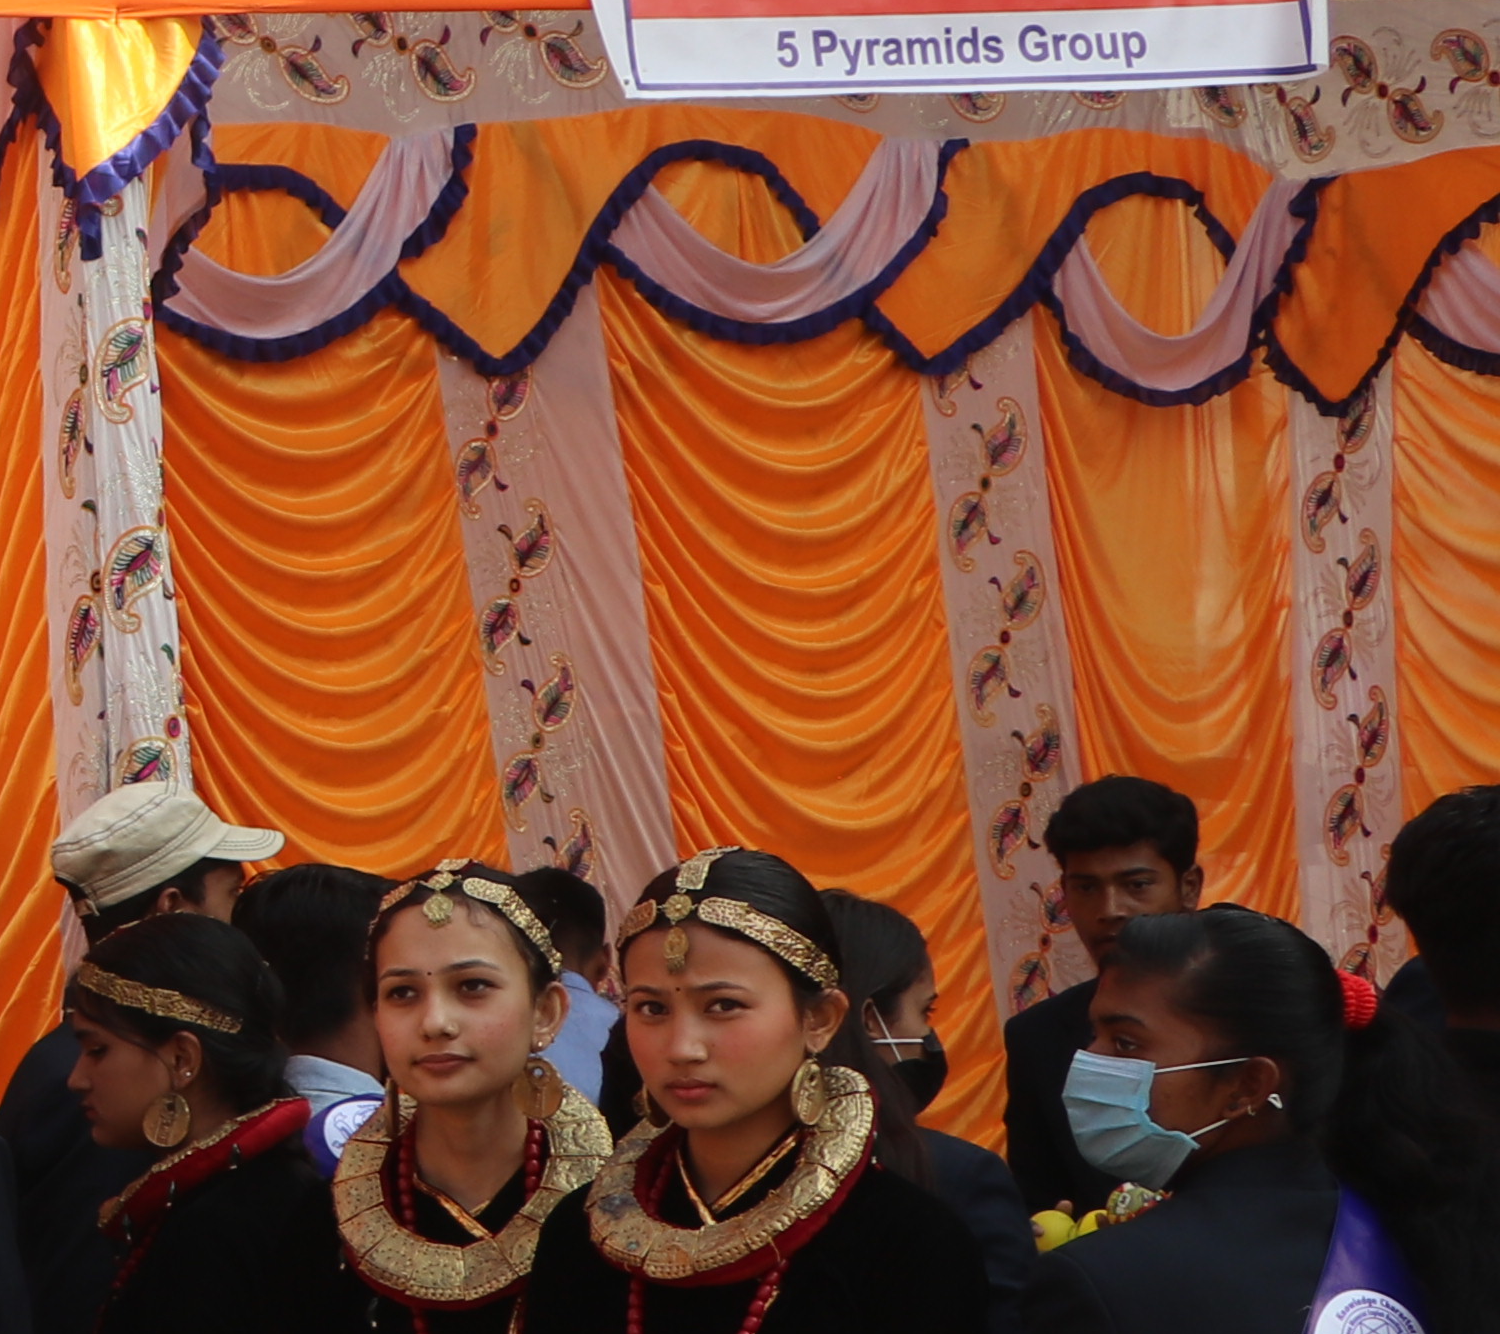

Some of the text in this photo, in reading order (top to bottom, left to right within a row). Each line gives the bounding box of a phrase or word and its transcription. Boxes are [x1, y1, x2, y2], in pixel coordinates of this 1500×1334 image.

[778, 25, 1146, 75] 5 Pyramids Group
